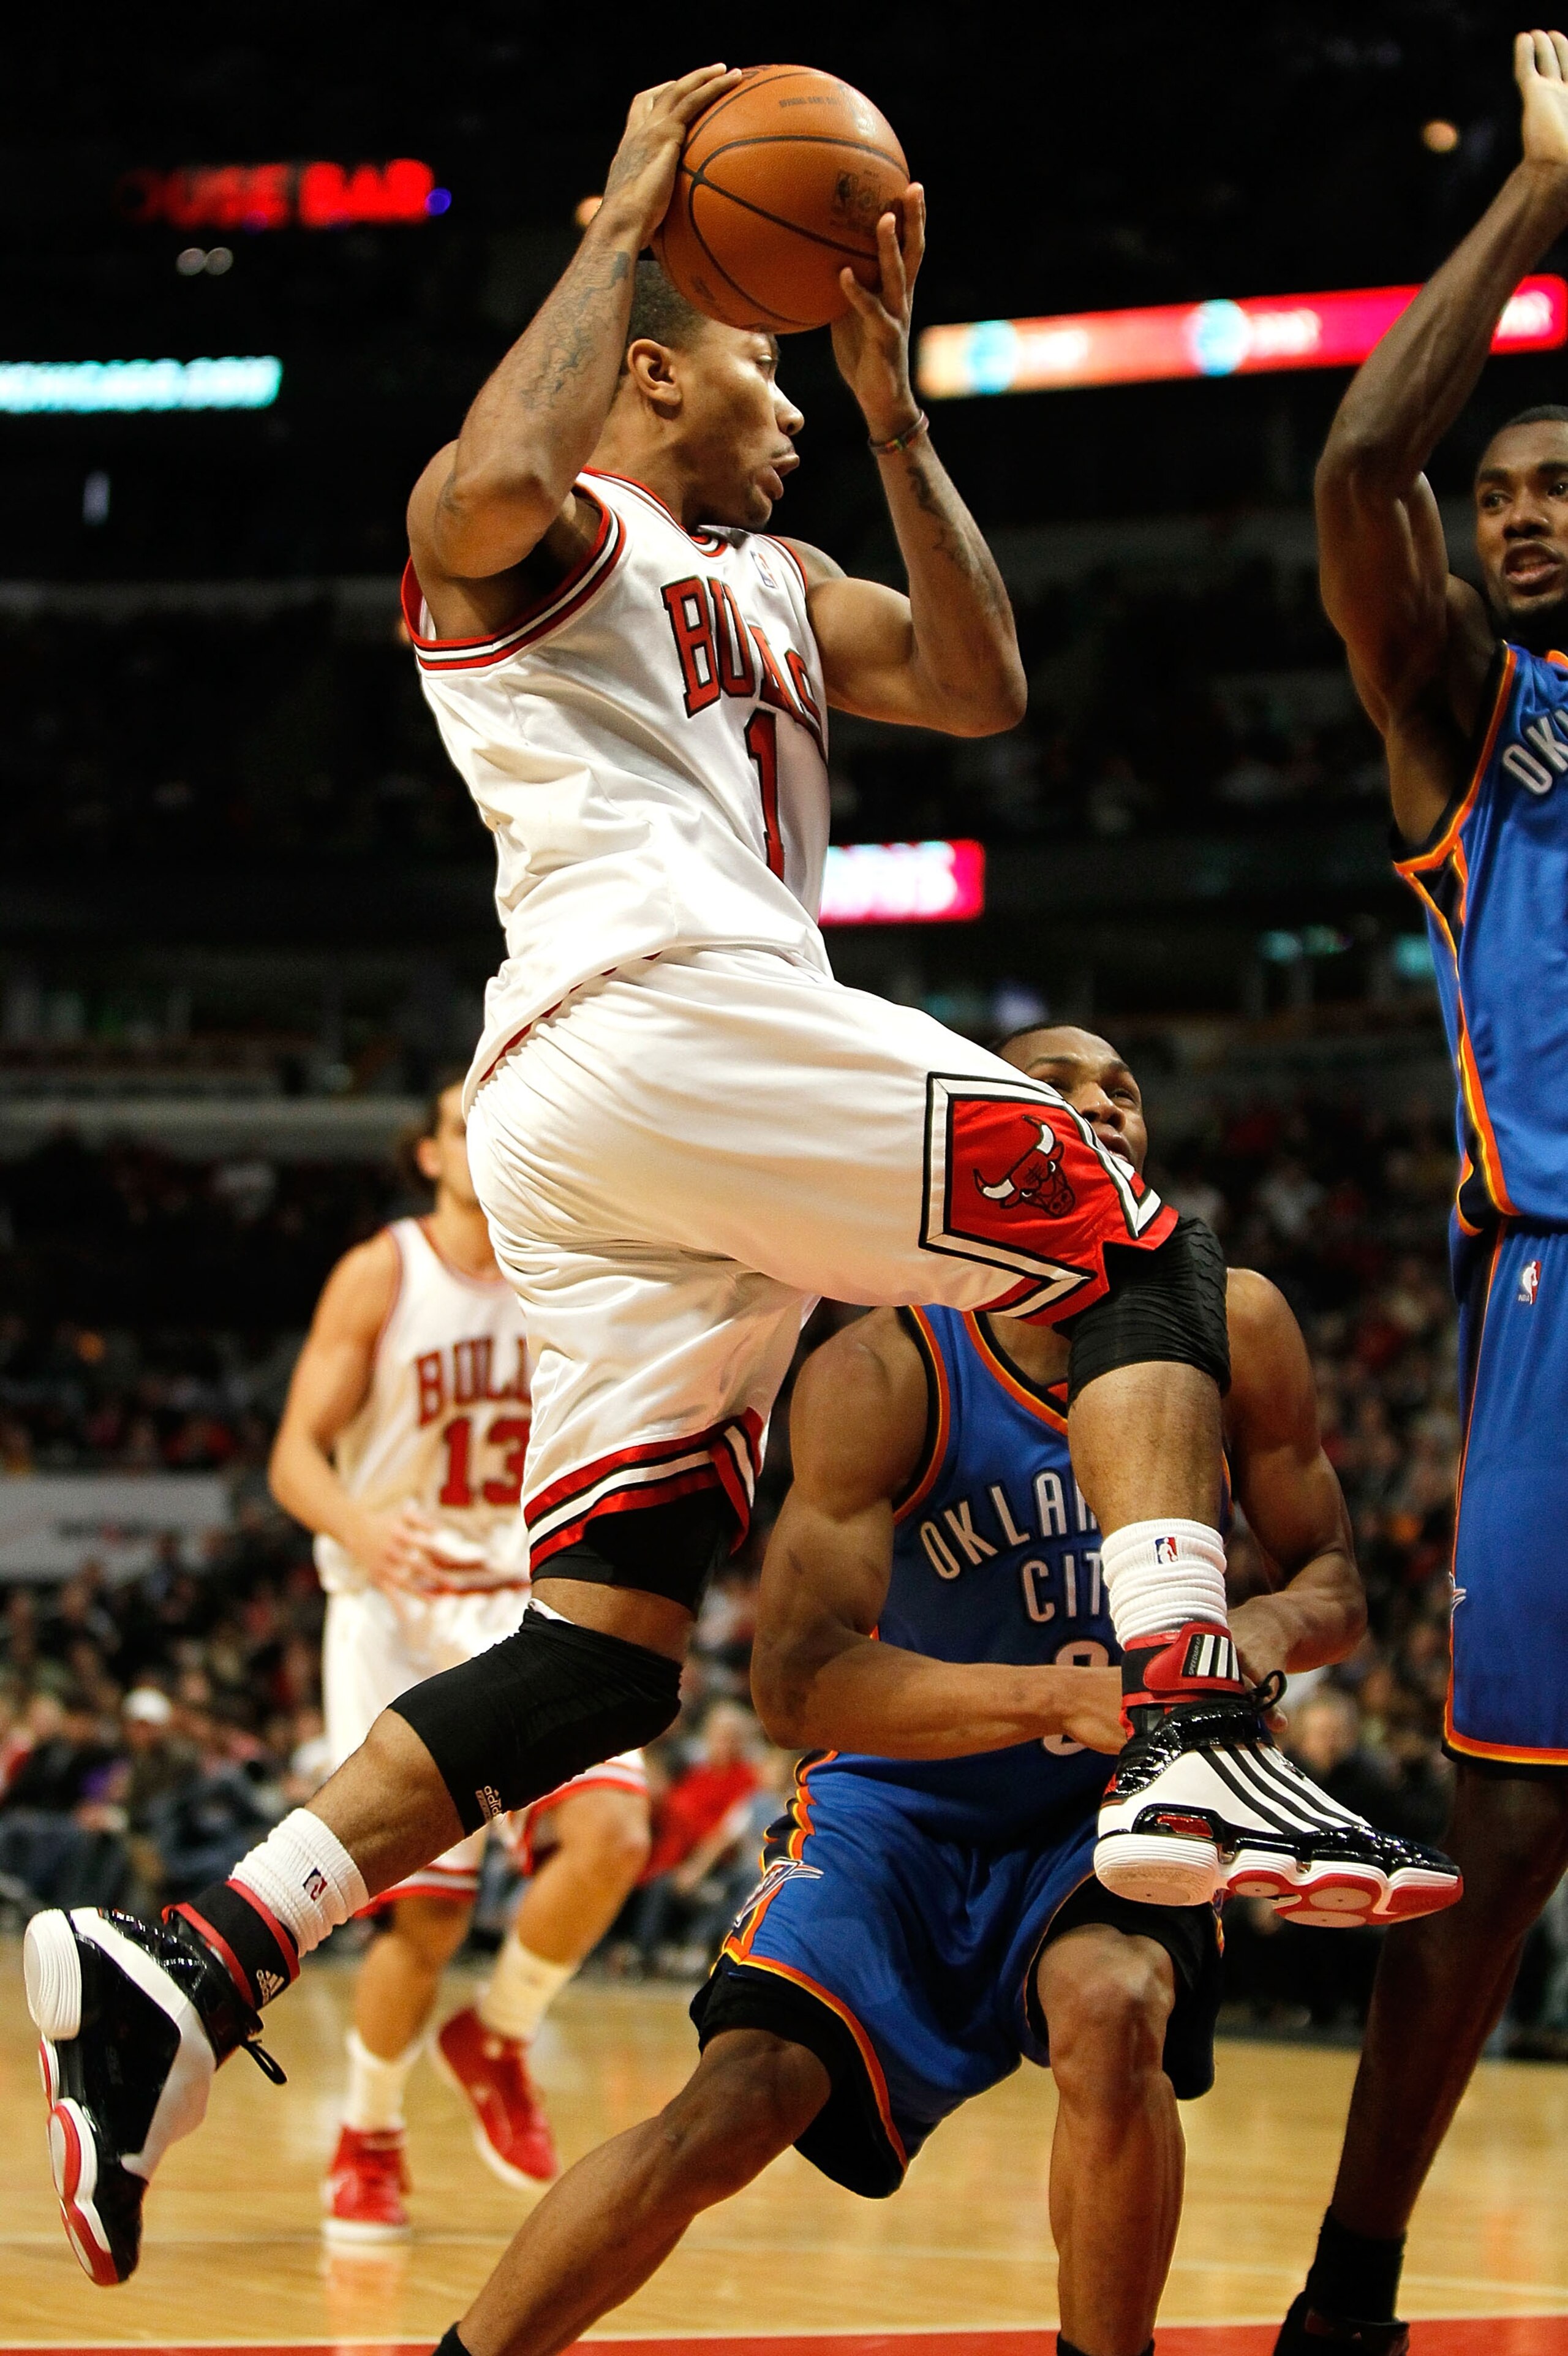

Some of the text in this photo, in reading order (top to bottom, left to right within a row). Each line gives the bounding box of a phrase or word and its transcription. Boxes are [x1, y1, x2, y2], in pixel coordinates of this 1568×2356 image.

[743, 707, 785, 883] 1
[1502, 709, 1568, 795] OK
[439, 1416, 532, 1507] 13
